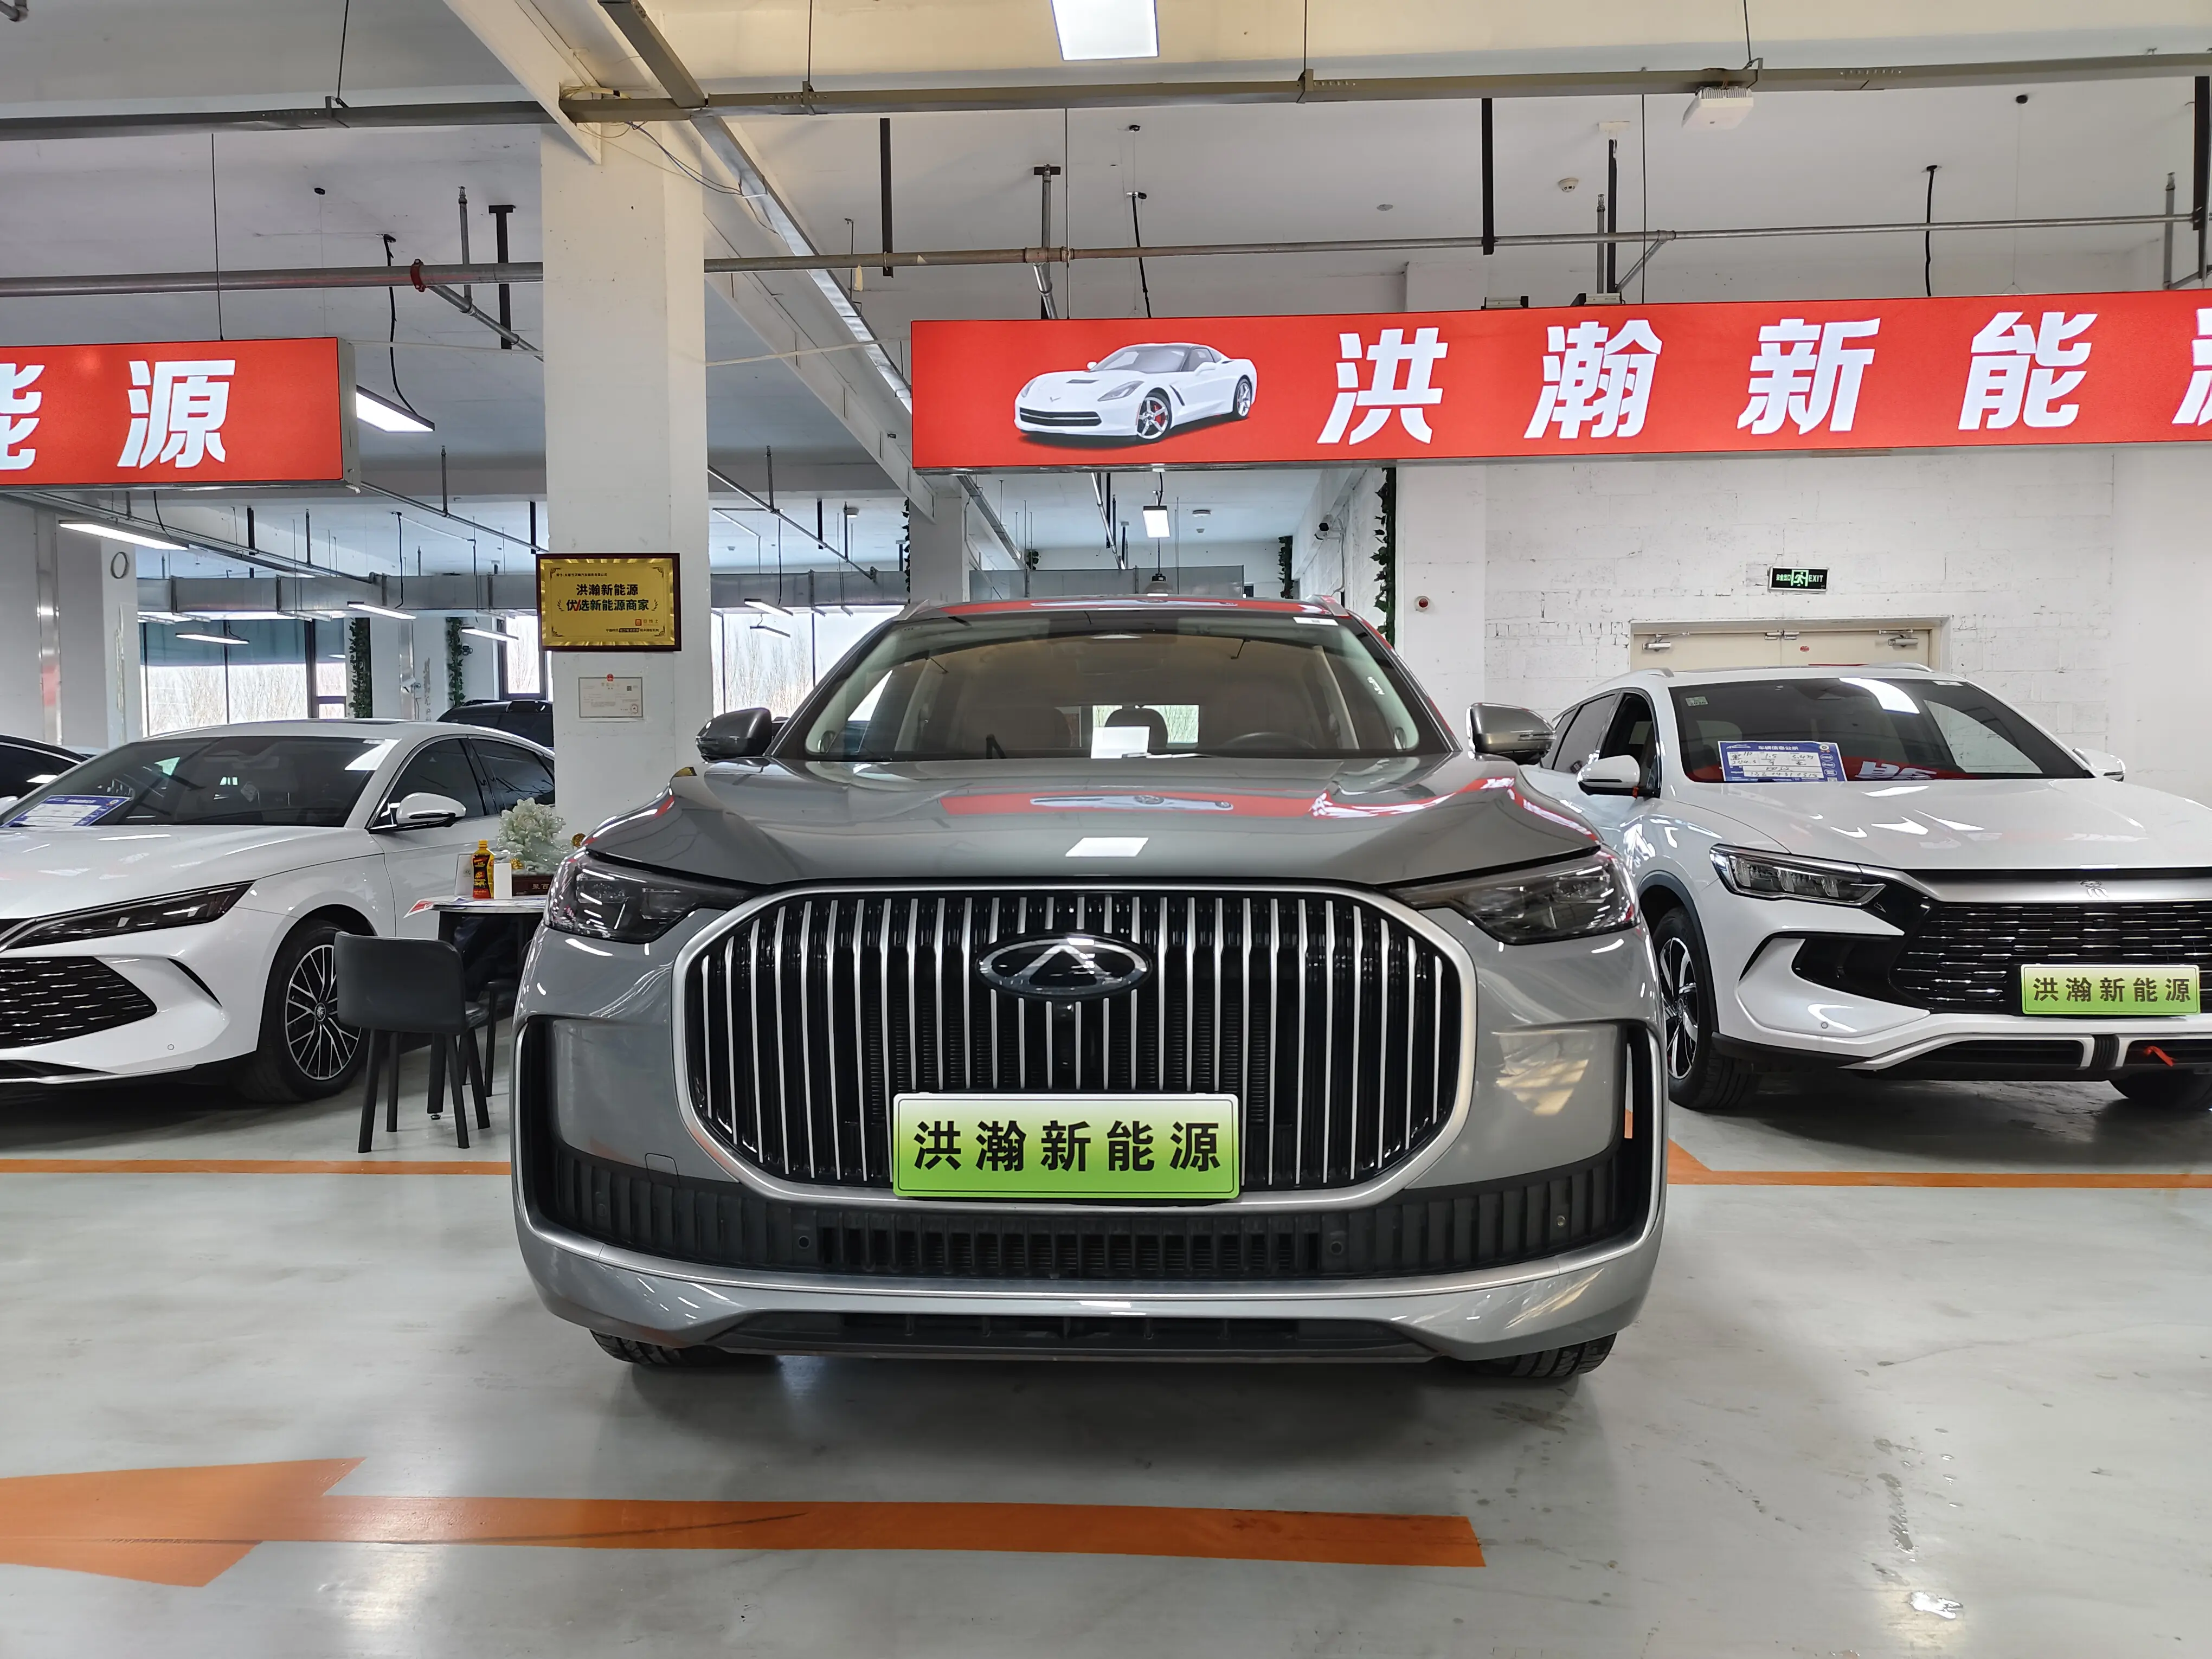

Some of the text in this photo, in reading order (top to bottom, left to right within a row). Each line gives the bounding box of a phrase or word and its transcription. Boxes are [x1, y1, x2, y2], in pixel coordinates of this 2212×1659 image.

[1317, 308, 2212, 445] 洪瀚新能
[1808, 575, 1824, 583] EXIT
[576, 583, 639, 596] 洪瀚新能源
[566, 599, 650, 612] 优选新能源商家
[2033, 976, 2191, 1003] 洪瀚新能源
[913, 1120, 1221, 1172] 洪瀚新能源
